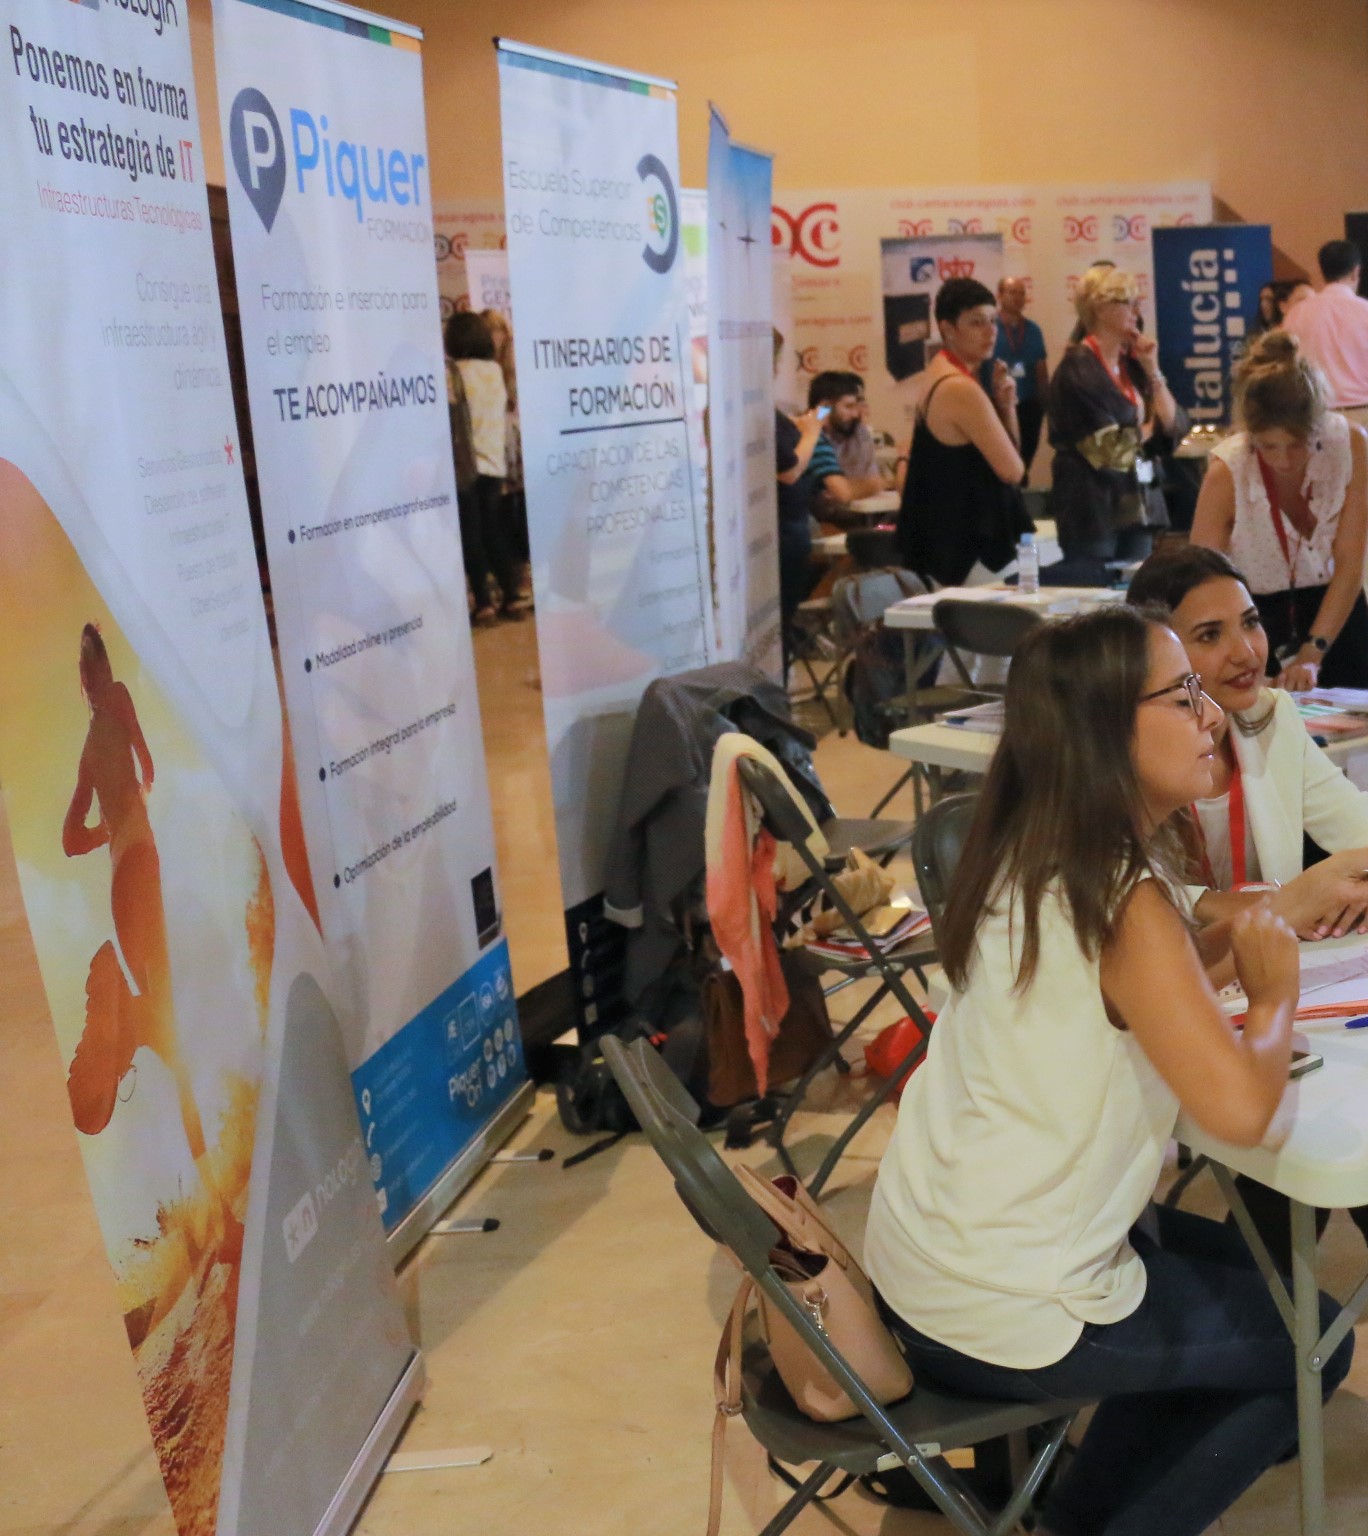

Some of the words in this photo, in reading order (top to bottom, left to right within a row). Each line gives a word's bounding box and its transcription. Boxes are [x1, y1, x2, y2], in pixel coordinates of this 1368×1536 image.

[9, 24, 109, 100] Ponemos
[113, 68, 136, 107] en
[137, 66, 188, 120] forma
[29, 105, 53, 156] tu
[57, 117, 153, 182] estrategia
[156, 135, 176, 180] de
[178, 140, 194, 183] IT
[289, 107, 425, 223] Piquer
[508, 160, 569, 195] Escuela
[37, 180, 135, 221] Infraestructuras
[510, 208, 534, 235] de
[261, 284, 332, 312] Formación
[335, 292, 345, 310] e
[267, 330, 281, 356] el
[284, 327, 331, 359] empleo
[533, 336, 646, 369] ITINERARIOS
[650, 336, 672, 364] DE
[273, 388, 302, 422] TE
[305, 371, 436, 419] ACOMPAÑAMOS
[568, 374, 677, 417] FORMACIÓN
[315, 641, 358, 669] Modalidad
